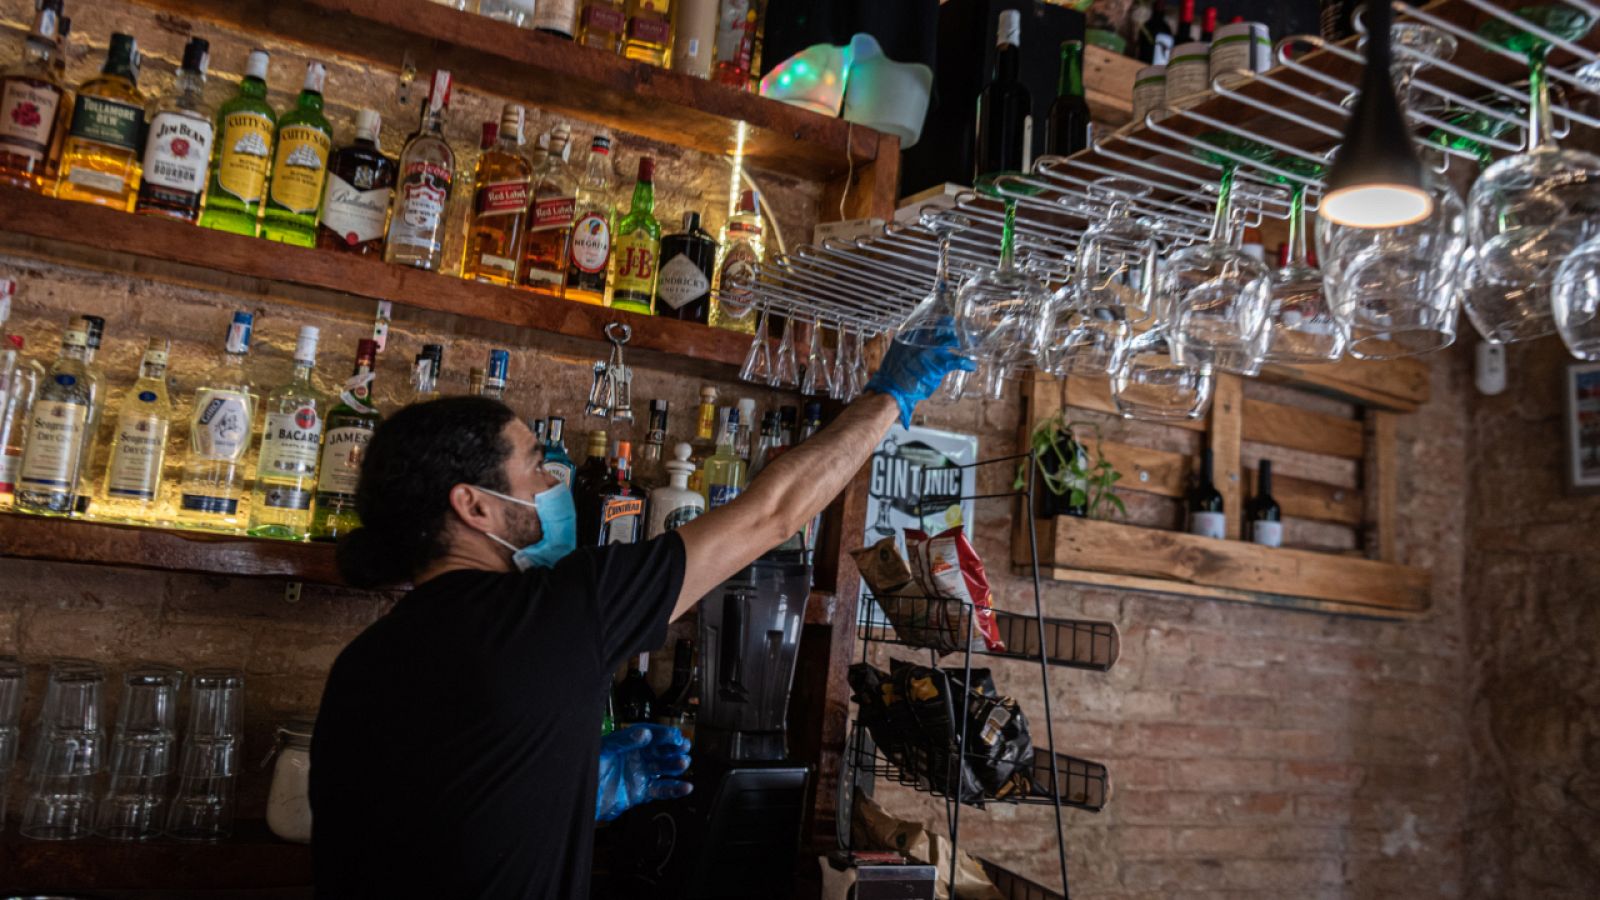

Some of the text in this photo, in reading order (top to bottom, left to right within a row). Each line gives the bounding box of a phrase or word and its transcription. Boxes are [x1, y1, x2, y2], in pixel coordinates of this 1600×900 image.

[156, 122, 178, 138] JIM
[278, 429, 319, 443] BACARD
[329, 432, 368, 445] JAMES
[871, 455, 908, 499] GIN
